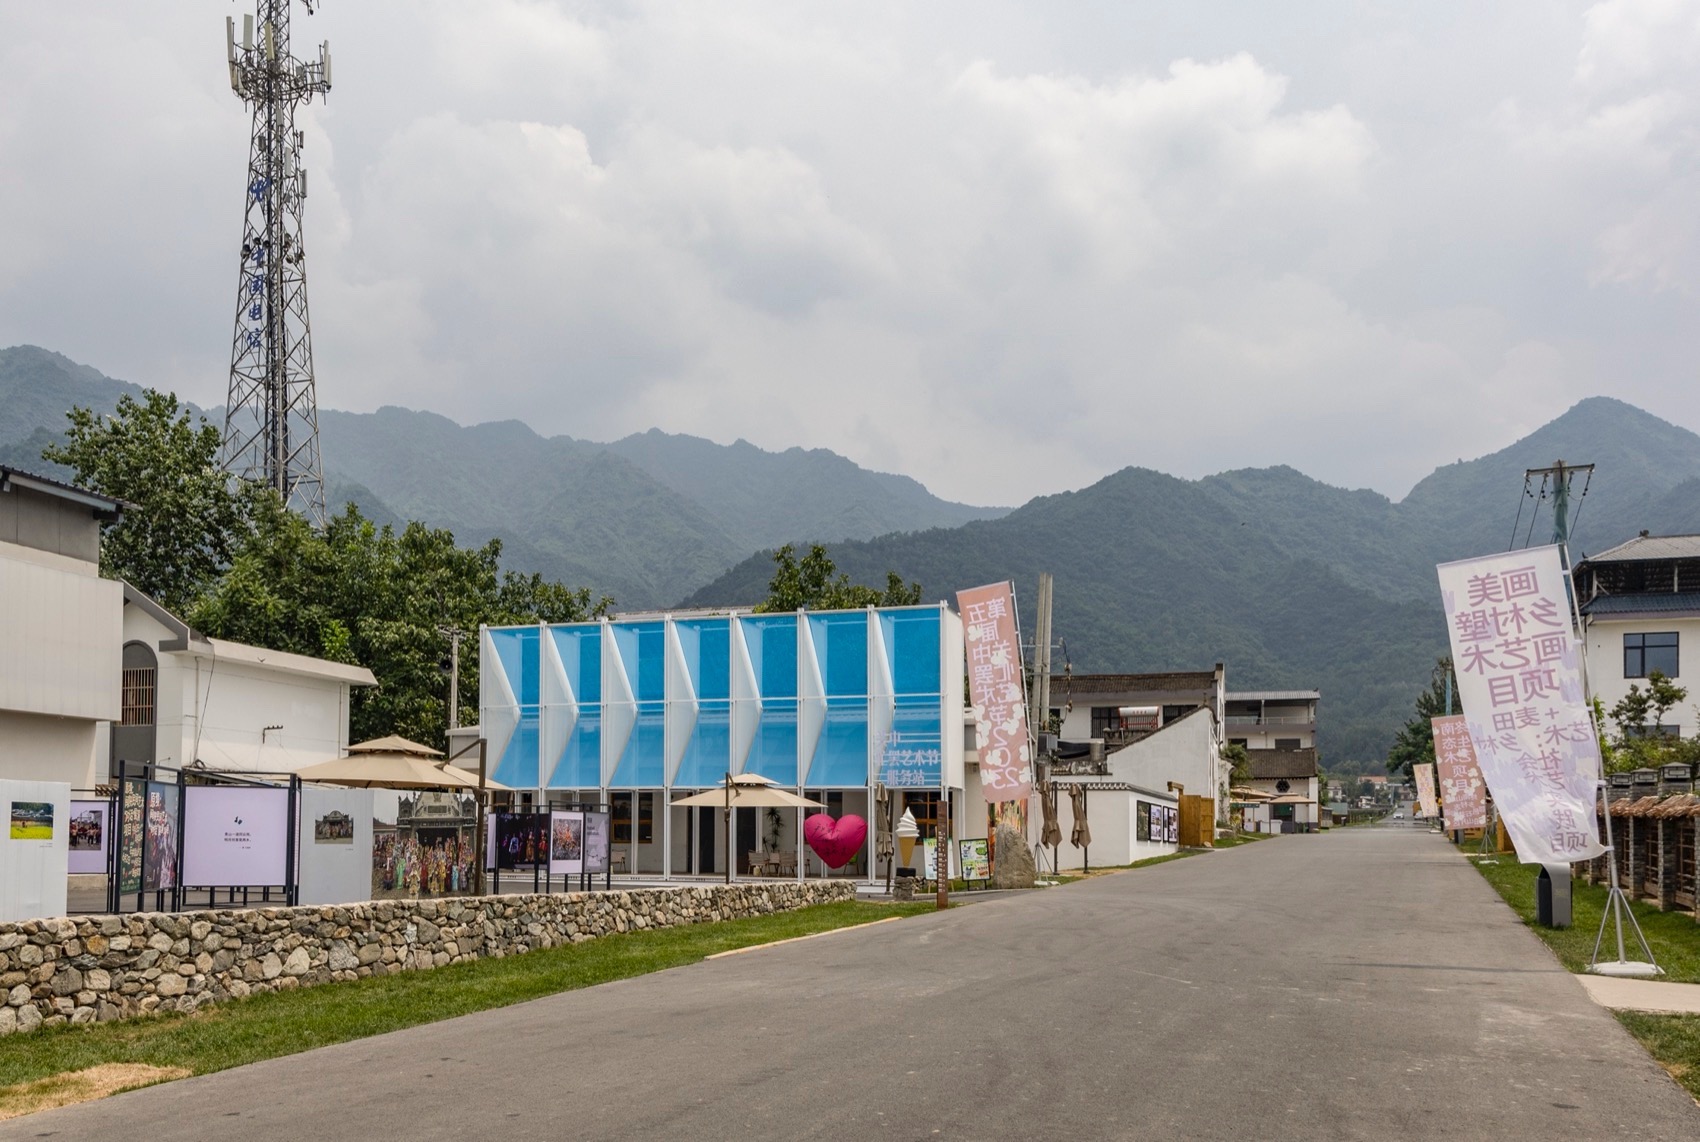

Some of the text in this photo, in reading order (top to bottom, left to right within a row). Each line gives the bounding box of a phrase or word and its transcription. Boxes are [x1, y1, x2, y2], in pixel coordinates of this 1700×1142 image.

[247, 247, 265, 348] 中国电信
[887, 769, 925, 786] 服务站
